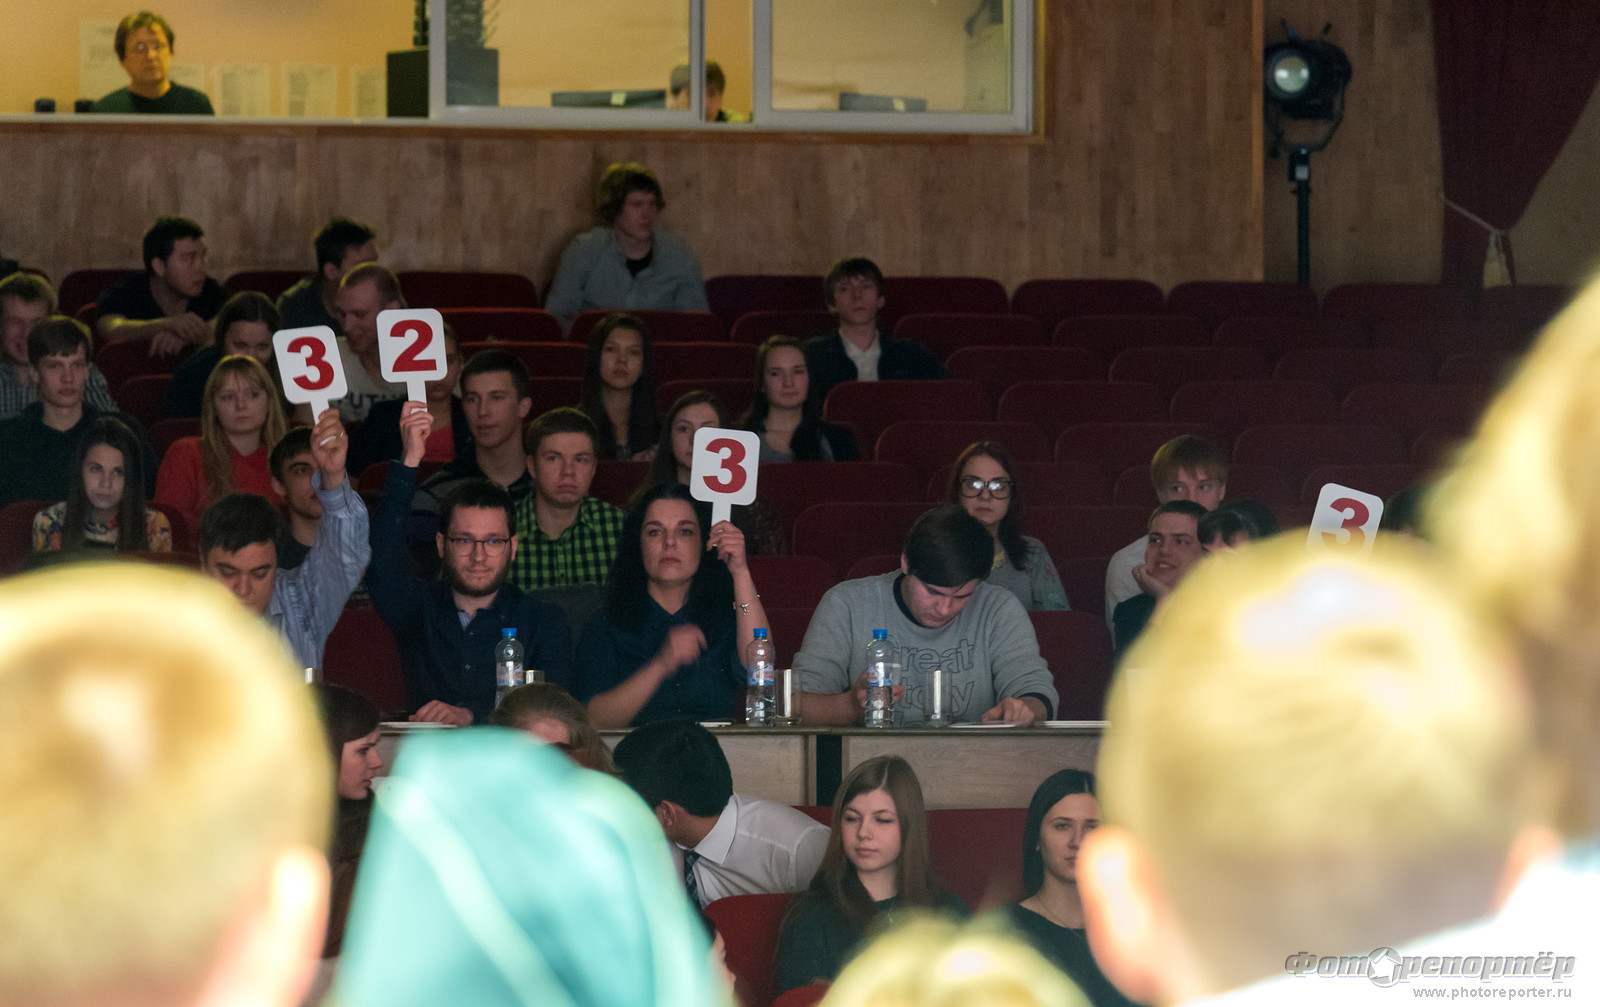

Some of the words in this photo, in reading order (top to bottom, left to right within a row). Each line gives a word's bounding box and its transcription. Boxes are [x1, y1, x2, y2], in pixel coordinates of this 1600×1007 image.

[287, 336, 335, 391] 3
[390, 319, 437, 373] 2
[702, 438, 748, 494] 3
[1321, 497, 1370, 555] 3
